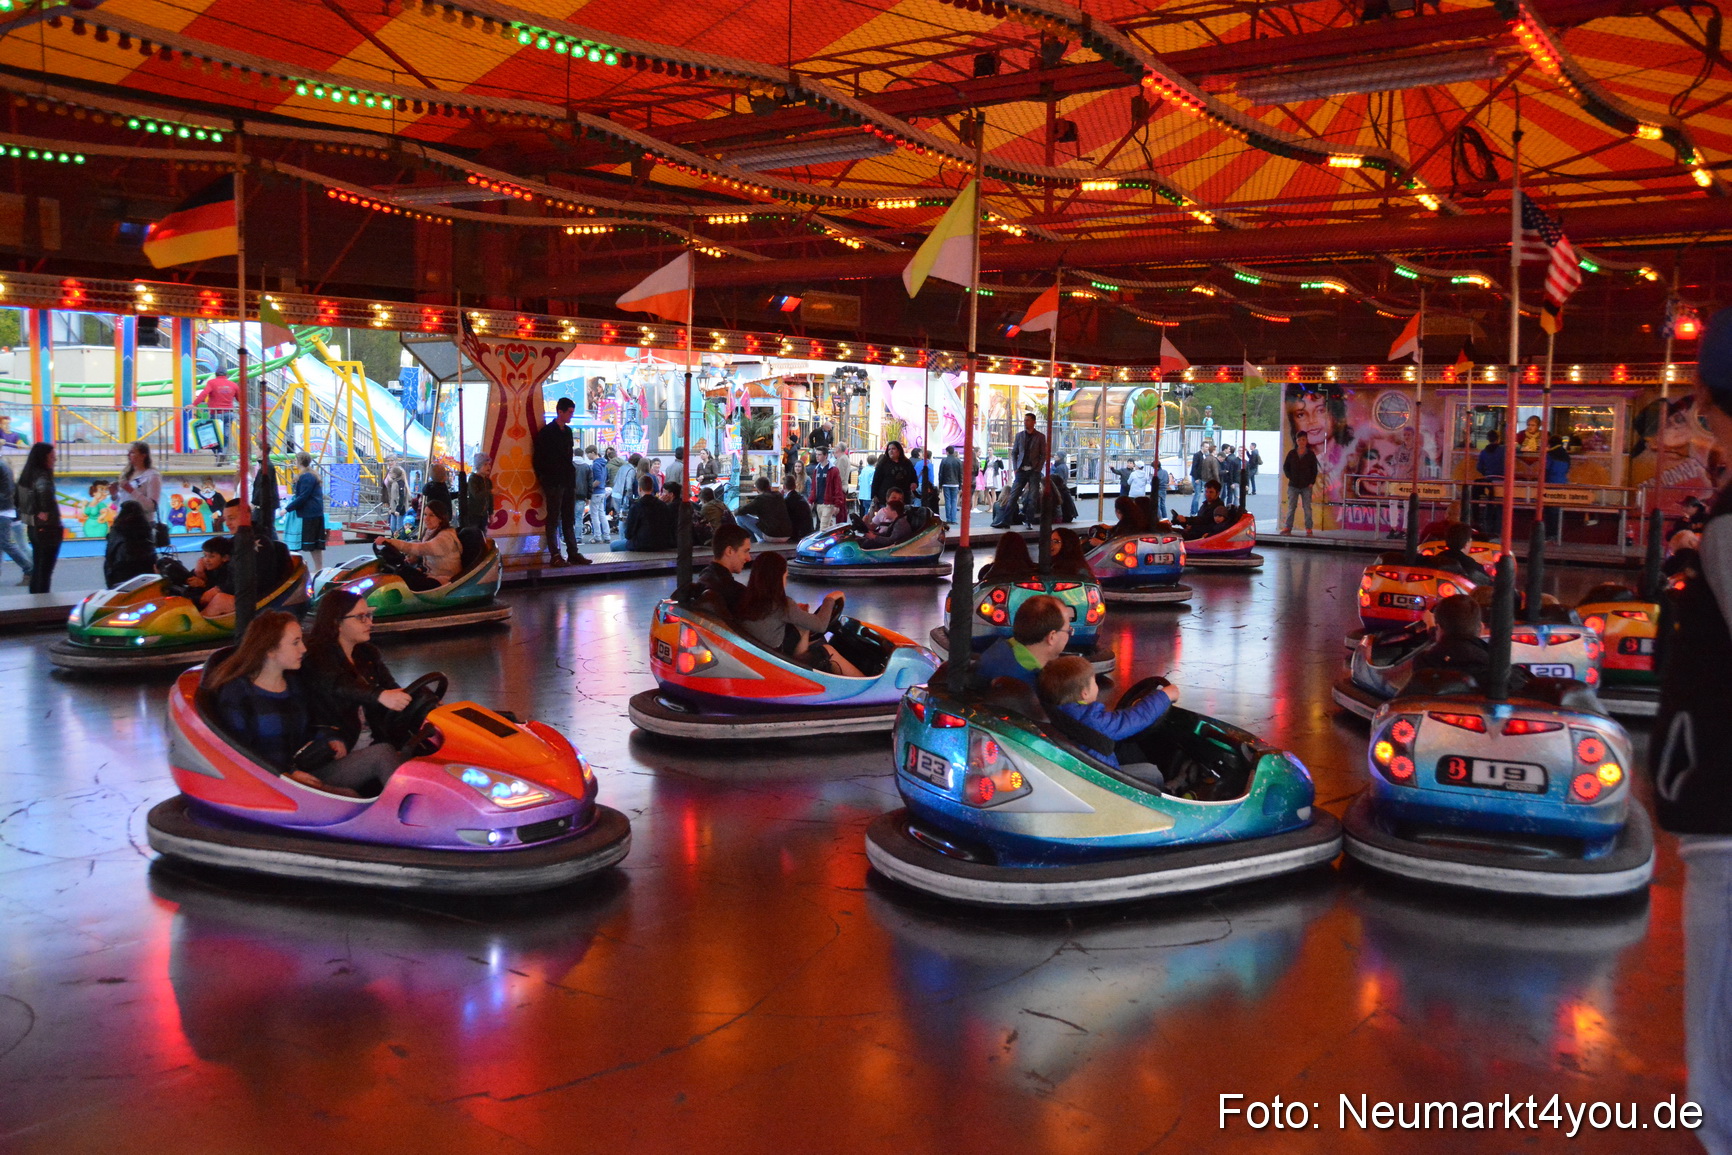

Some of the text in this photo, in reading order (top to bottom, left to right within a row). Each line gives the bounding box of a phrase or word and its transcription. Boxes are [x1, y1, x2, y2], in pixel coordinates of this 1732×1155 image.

[1535, 666, 1566, 677] 20
[922, 755, 945, 776] 23
[1488, 765, 1527, 781] 19
